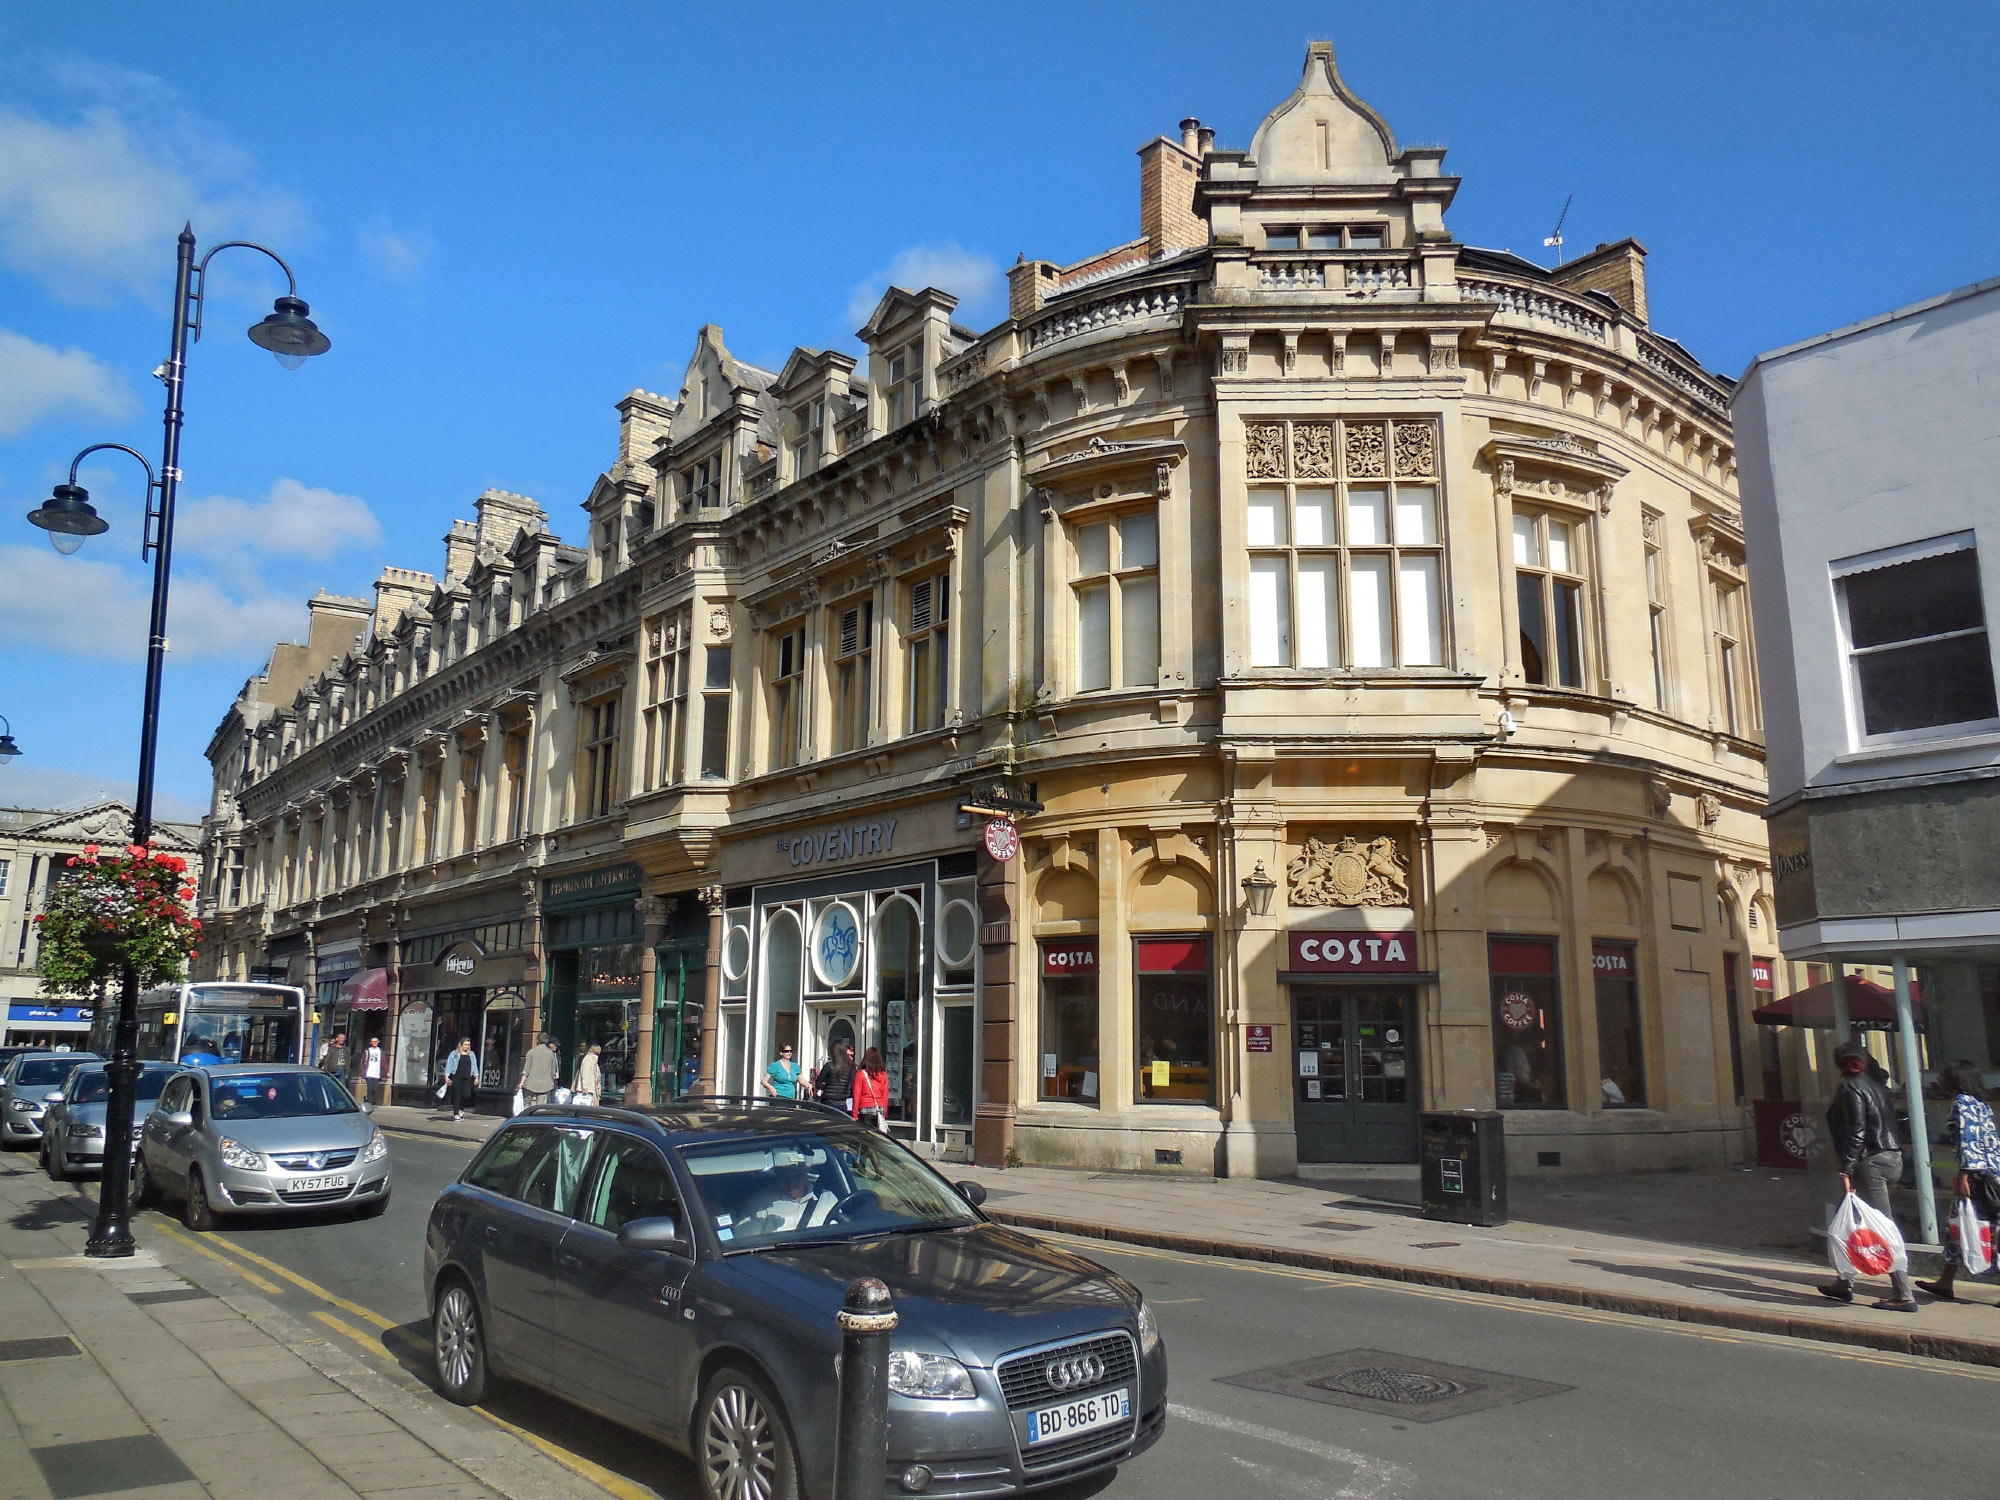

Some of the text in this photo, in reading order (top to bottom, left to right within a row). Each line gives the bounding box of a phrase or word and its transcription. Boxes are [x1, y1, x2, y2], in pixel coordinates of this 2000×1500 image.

[990, 819, 1013, 833] COSTA
[777, 819, 897, 867] the COVENTRY
[989, 841, 1016, 858] COFFEE
[1776, 851, 1807, 883] JONES
[1048, 951, 1094, 966] COSTA
[1300, 938, 1407, 965] COSTA
[1505, 993, 1529, 1005] COSTA
[1504, 1013, 1533, 1027] COFFEE
[483, 1069, 501, 1088] £199
[292, 1175, 345, 1191] KY57 FUG
[1121, 1401, 1130, 1415] 12
